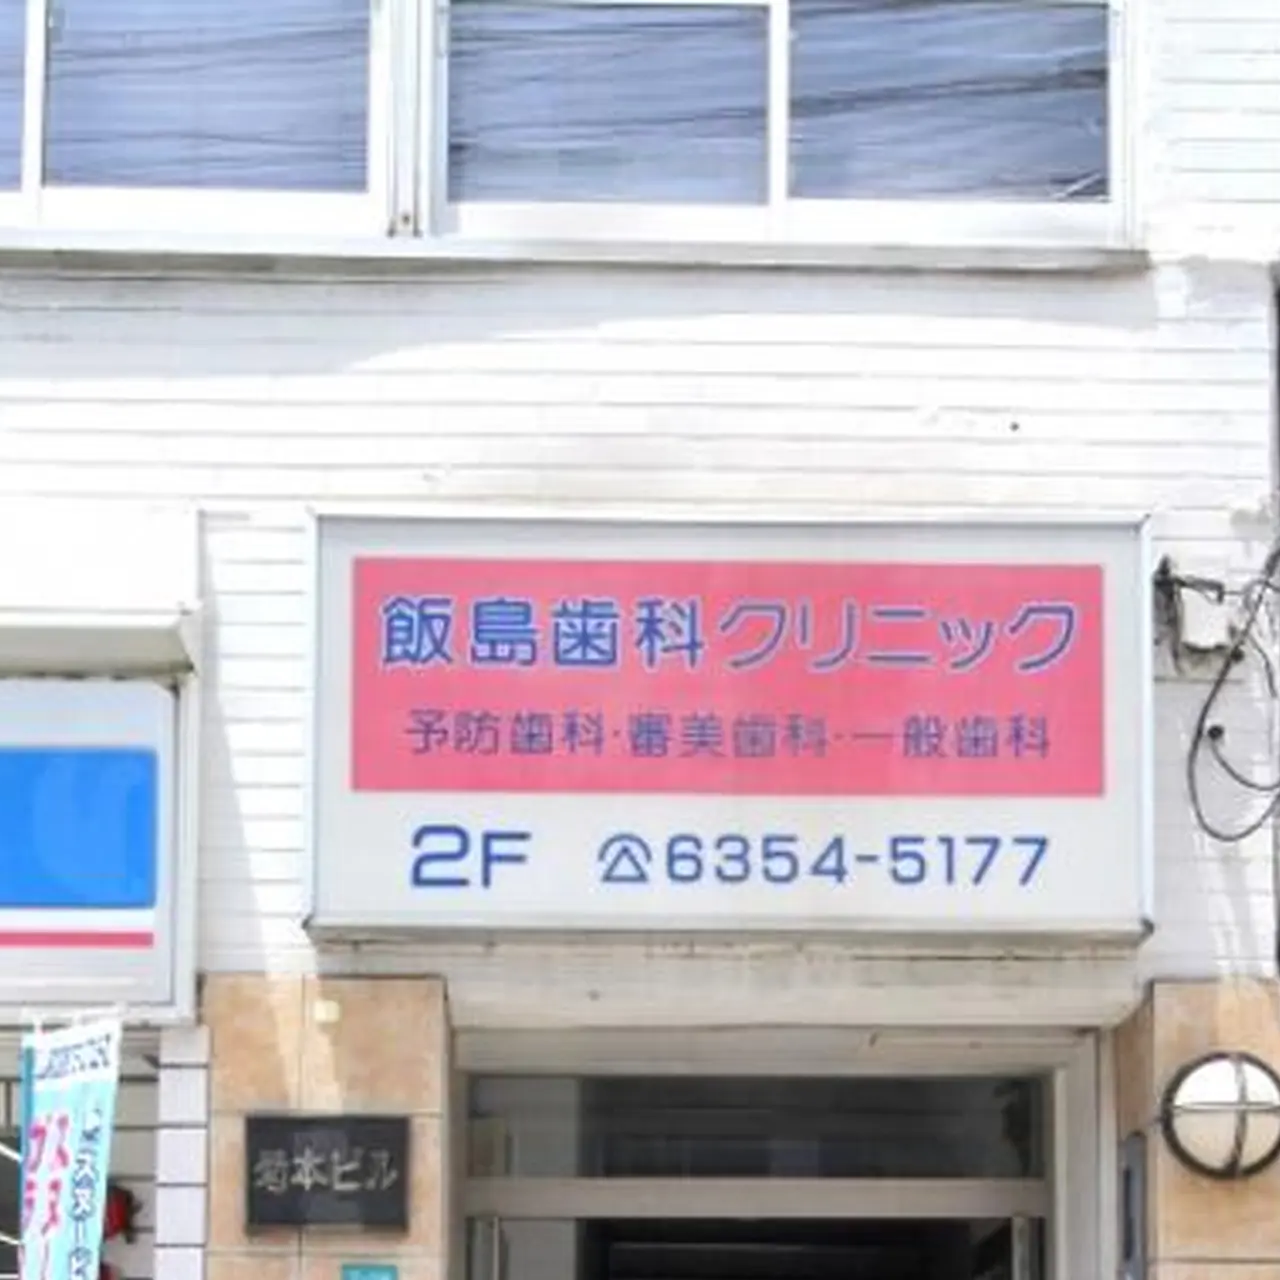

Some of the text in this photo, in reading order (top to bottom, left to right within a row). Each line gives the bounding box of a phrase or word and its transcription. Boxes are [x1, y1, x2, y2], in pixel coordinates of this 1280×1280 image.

[378, 594, 1078, 679] 飯島歯科クリニック
[409, 823, 1051, 890] 2F 6354-5177
